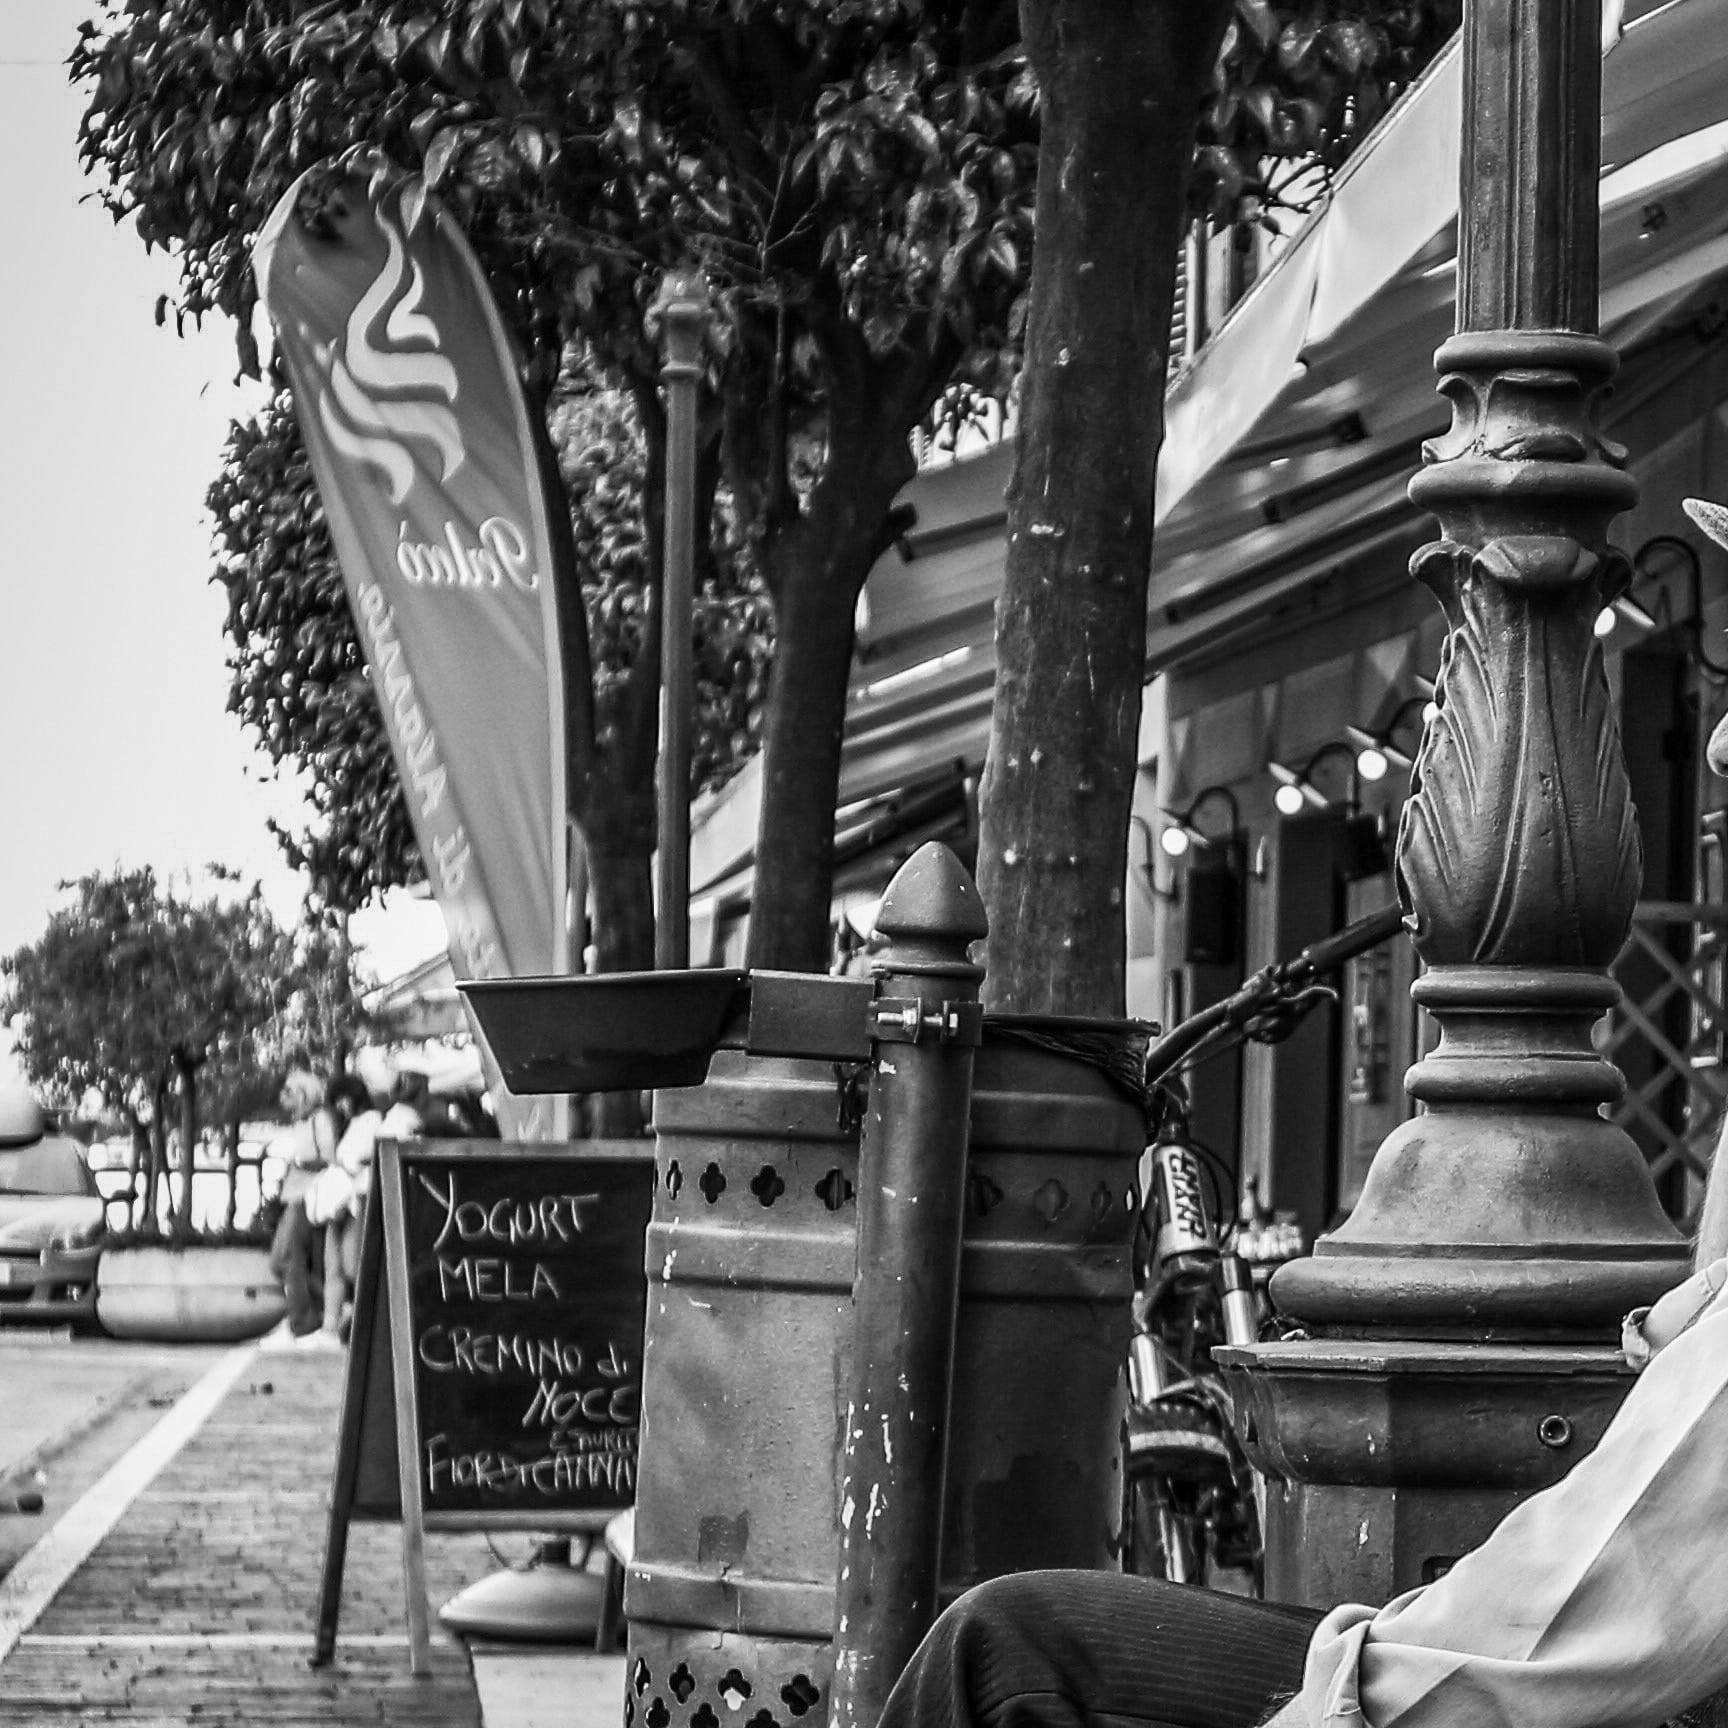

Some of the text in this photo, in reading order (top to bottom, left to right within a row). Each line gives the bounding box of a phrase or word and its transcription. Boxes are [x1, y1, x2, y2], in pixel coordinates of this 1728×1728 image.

[419, 1170, 599, 1251] YOGURT
[437, 1256, 560, 1302] MELA
[419, 1324, 582, 1376] CREMINO
